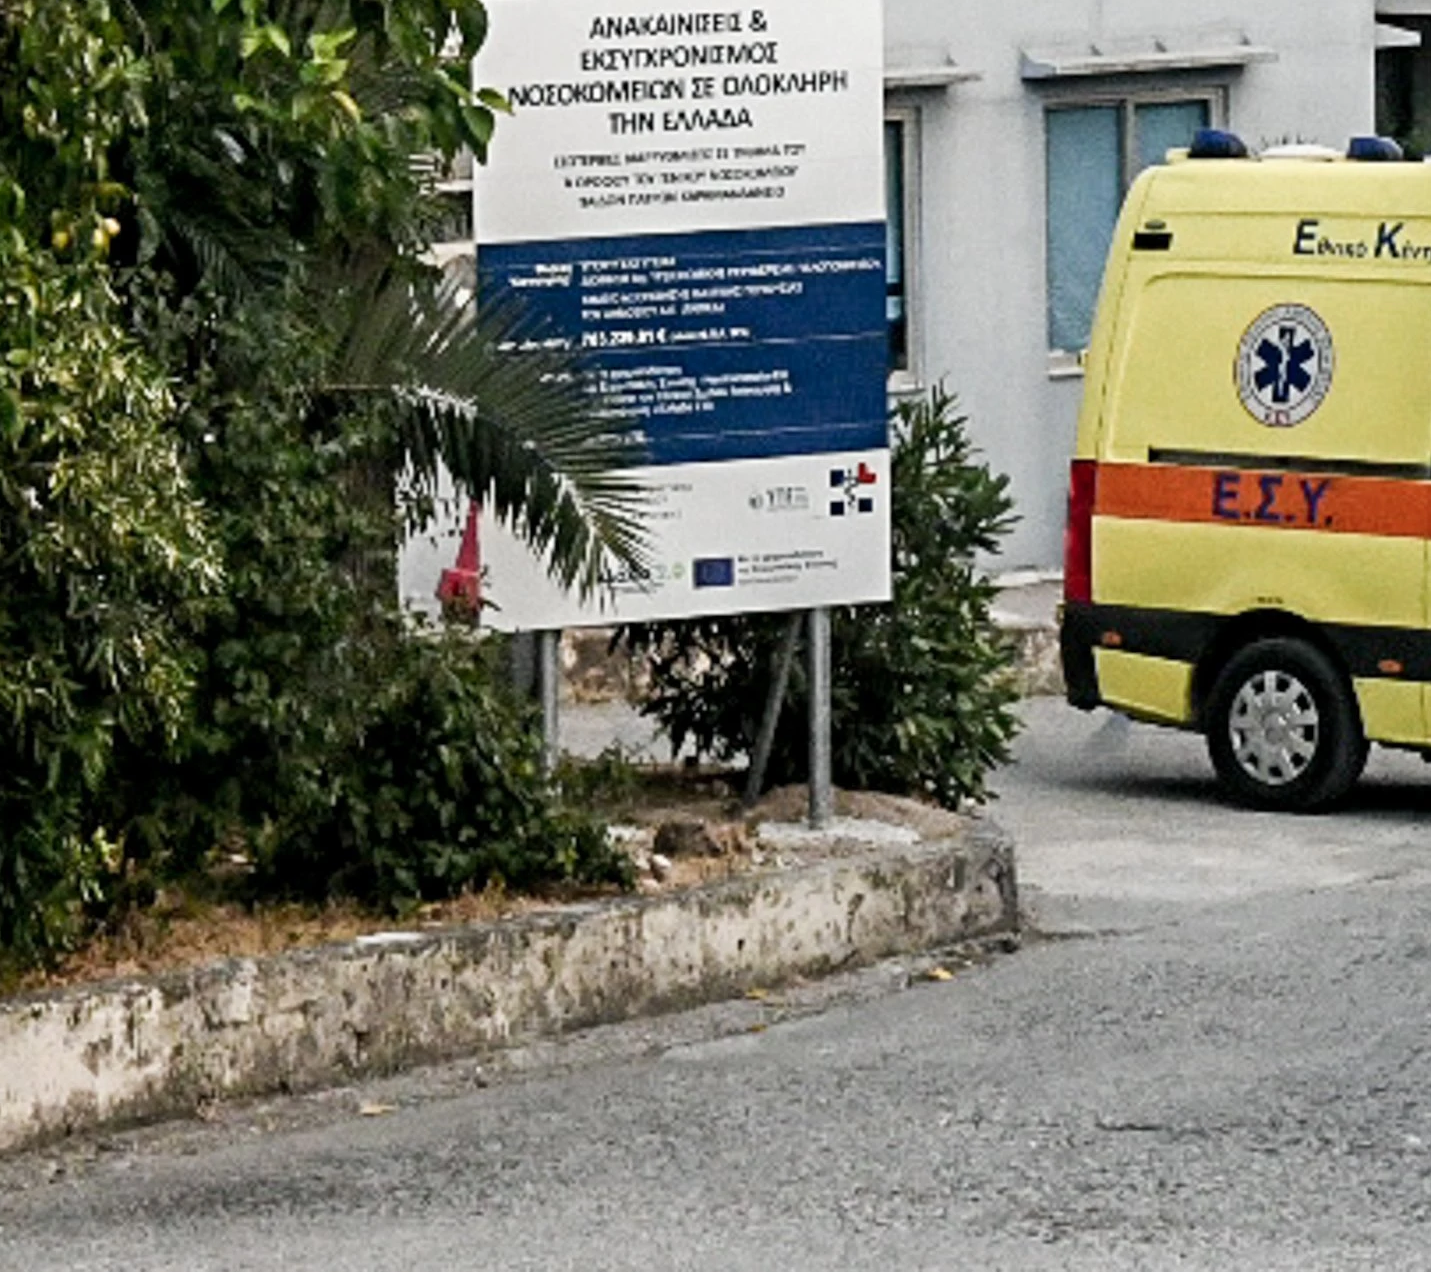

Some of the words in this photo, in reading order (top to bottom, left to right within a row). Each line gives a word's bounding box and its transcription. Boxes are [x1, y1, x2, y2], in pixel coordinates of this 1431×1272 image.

[589, 11, 743, 40] ΑΝΑΚΑΙΝΙΣΕΙΣ
[748, 9, 768, 33] &
[580, 41, 778, 71] ΕΚΣΥΓΧΡΟΝΙΣΜΟΣ
[506, 78, 685, 107] ΝΟΣΟΚΟΜΕΙΩΝ
[691, 76, 715, 100] ΣΕ
[722, 70, 849, 97] ΟΛΟΚΛΗΡΗ
[608, 111, 654, 135] ΤΗΝ
[663, 108, 753, 132] ΕΛΛΑΔΑ
[1292, 219, 1368, 257] Εθνικό
[1212, 470, 1333, 526] Ε.Σ.Υ.
